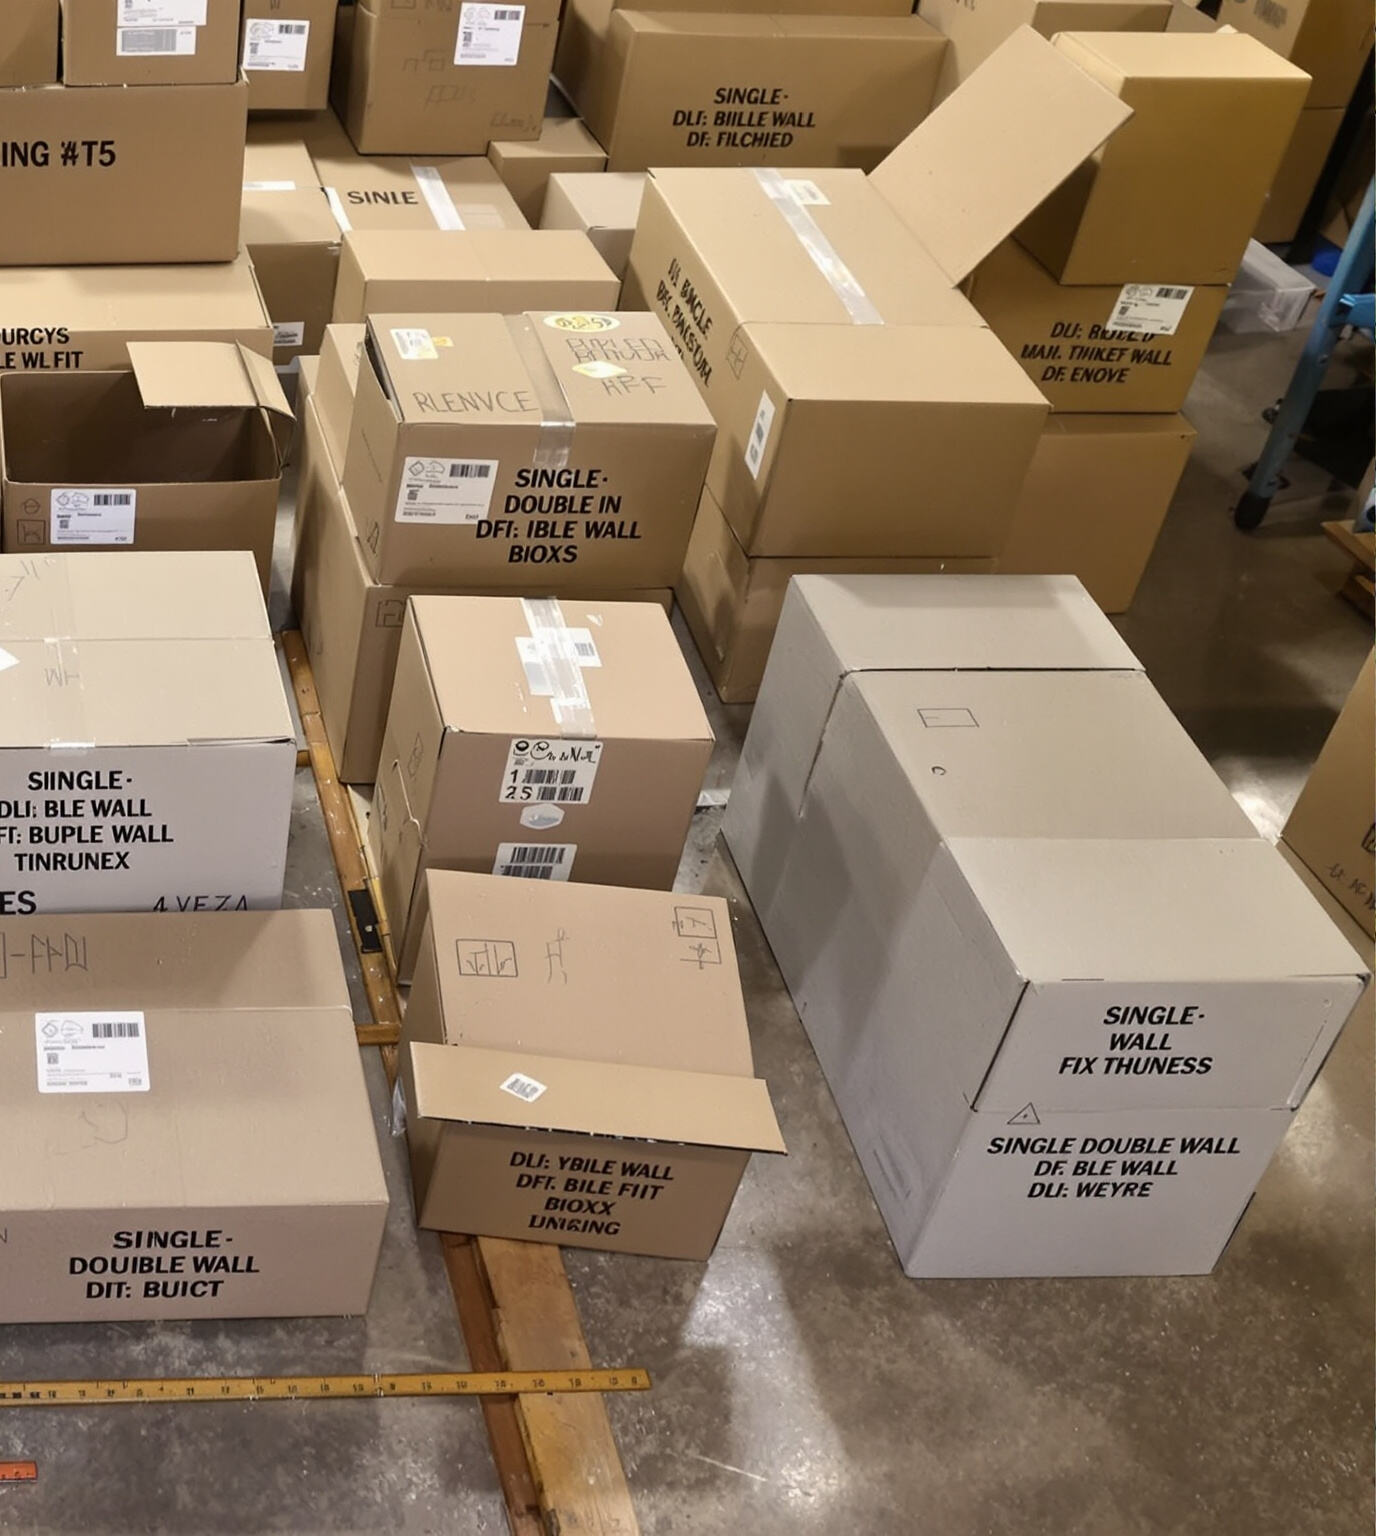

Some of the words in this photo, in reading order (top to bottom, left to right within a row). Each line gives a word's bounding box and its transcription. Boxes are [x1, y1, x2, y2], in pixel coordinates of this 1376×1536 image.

[772, 111, 816, 128] WALL
[60, 140, 116, 167] #T5
[54, 351, 83, 369] FIT
[1130, 349, 1172, 366] WALL
[504, 494, 594, 514] DOUBLE
[598, 495, 622, 514] IN
[584, 519, 642, 539] WALL
[508, 545, 579, 564] BIOXS
[44, 799, 85, 818] BLE
[91, 798, 152, 818] WALL
[28, 825, 103, 844] BUPLE
[111, 824, 174, 843] WALL
[13, 851, 131, 872] TINRUNEX
[1109, 1032, 1173, 1051] WALL
[1058, 1056, 1099, 1075] FIX
[1103, 1056, 1214, 1075] THUNESS
[986, 1136, 1077, 1155] SINGLE
[1078, 1136, 1176, 1155] DOUBLE
[1179, 1136, 1241, 1154] WALL
[557, 1155, 617, 1175] YBILE
[620, 1161, 675, 1181] WALL
[1071, 1160, 1118, 1176] BLE
[1120, 1160, 1178, 1176] WALL
[563, 1177, 614, 1195] BILE
[1075, 1182, 1155, 1198] WEYRE
[544, 1196, 617, 1216] BIOXX
[192, 1255, 261, 1274] WALL
[143, 1280, 225, 1299] BUICT
